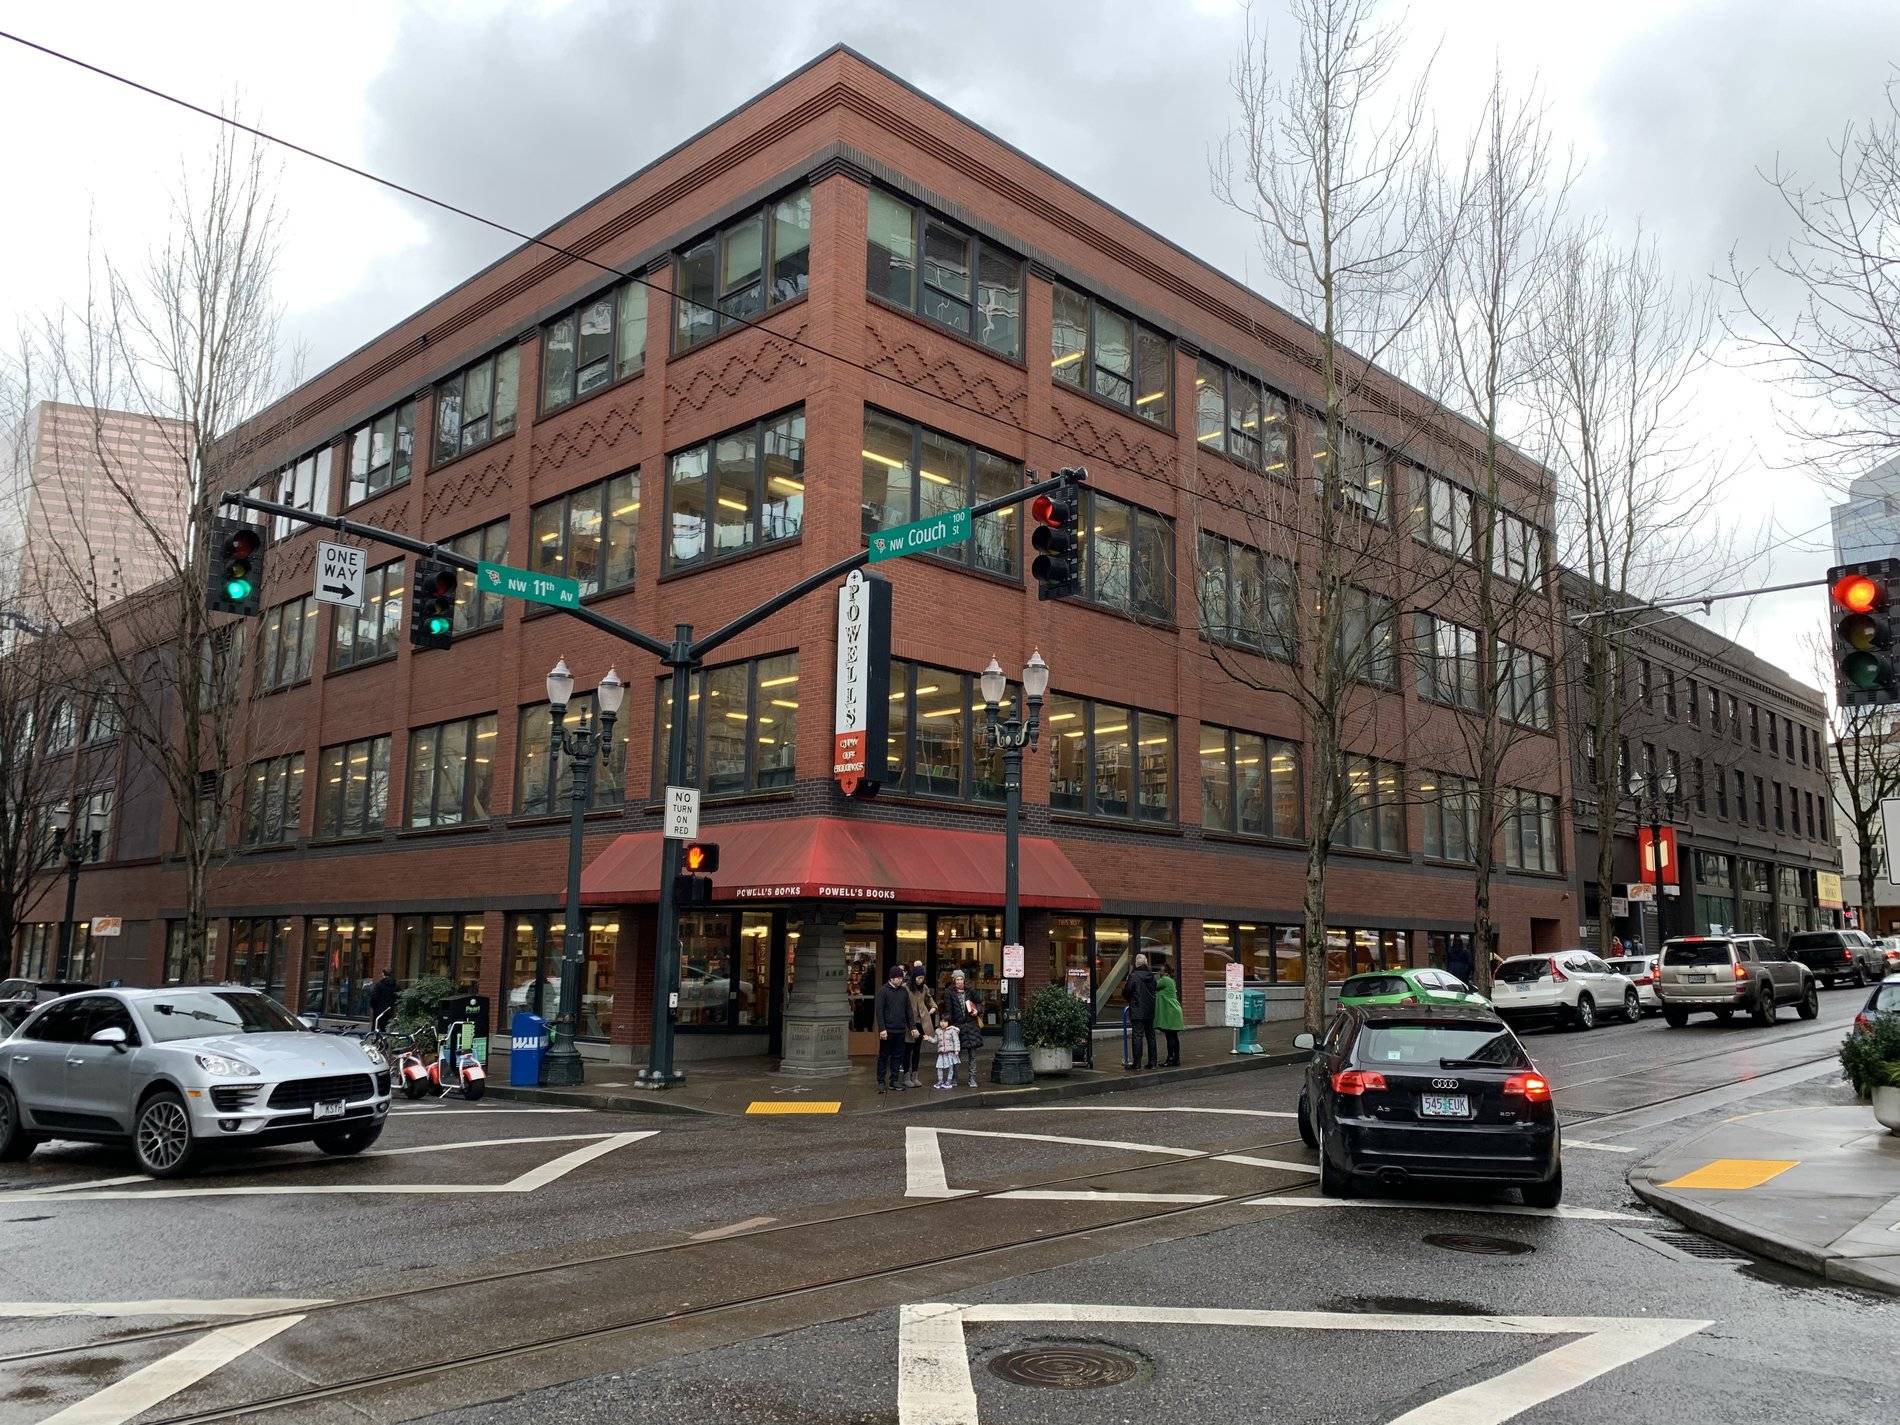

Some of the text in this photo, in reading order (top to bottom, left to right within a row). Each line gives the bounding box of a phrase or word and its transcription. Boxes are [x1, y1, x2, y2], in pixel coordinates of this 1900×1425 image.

[953, 511, 965, 523] 100
[889, 520, 960, 552] NW Couch St
[327, 548, 358, 566] ONE
[324, 563, 358, 581] WAY
[508, 579, 573, 602] NW 11th Av
[675, 792, 691, 803] NO
[673, 804, 693, 813] TURN
[676, 815, 688, 824] ON
[674, 826, 689, 835] RED
[736, 886, 800, 897] POWELL'S BOOKS
[819, 887, 895, 899] POWELL'S BOOKS
[1424, 1097, 1467, 1112] 545 EUK
